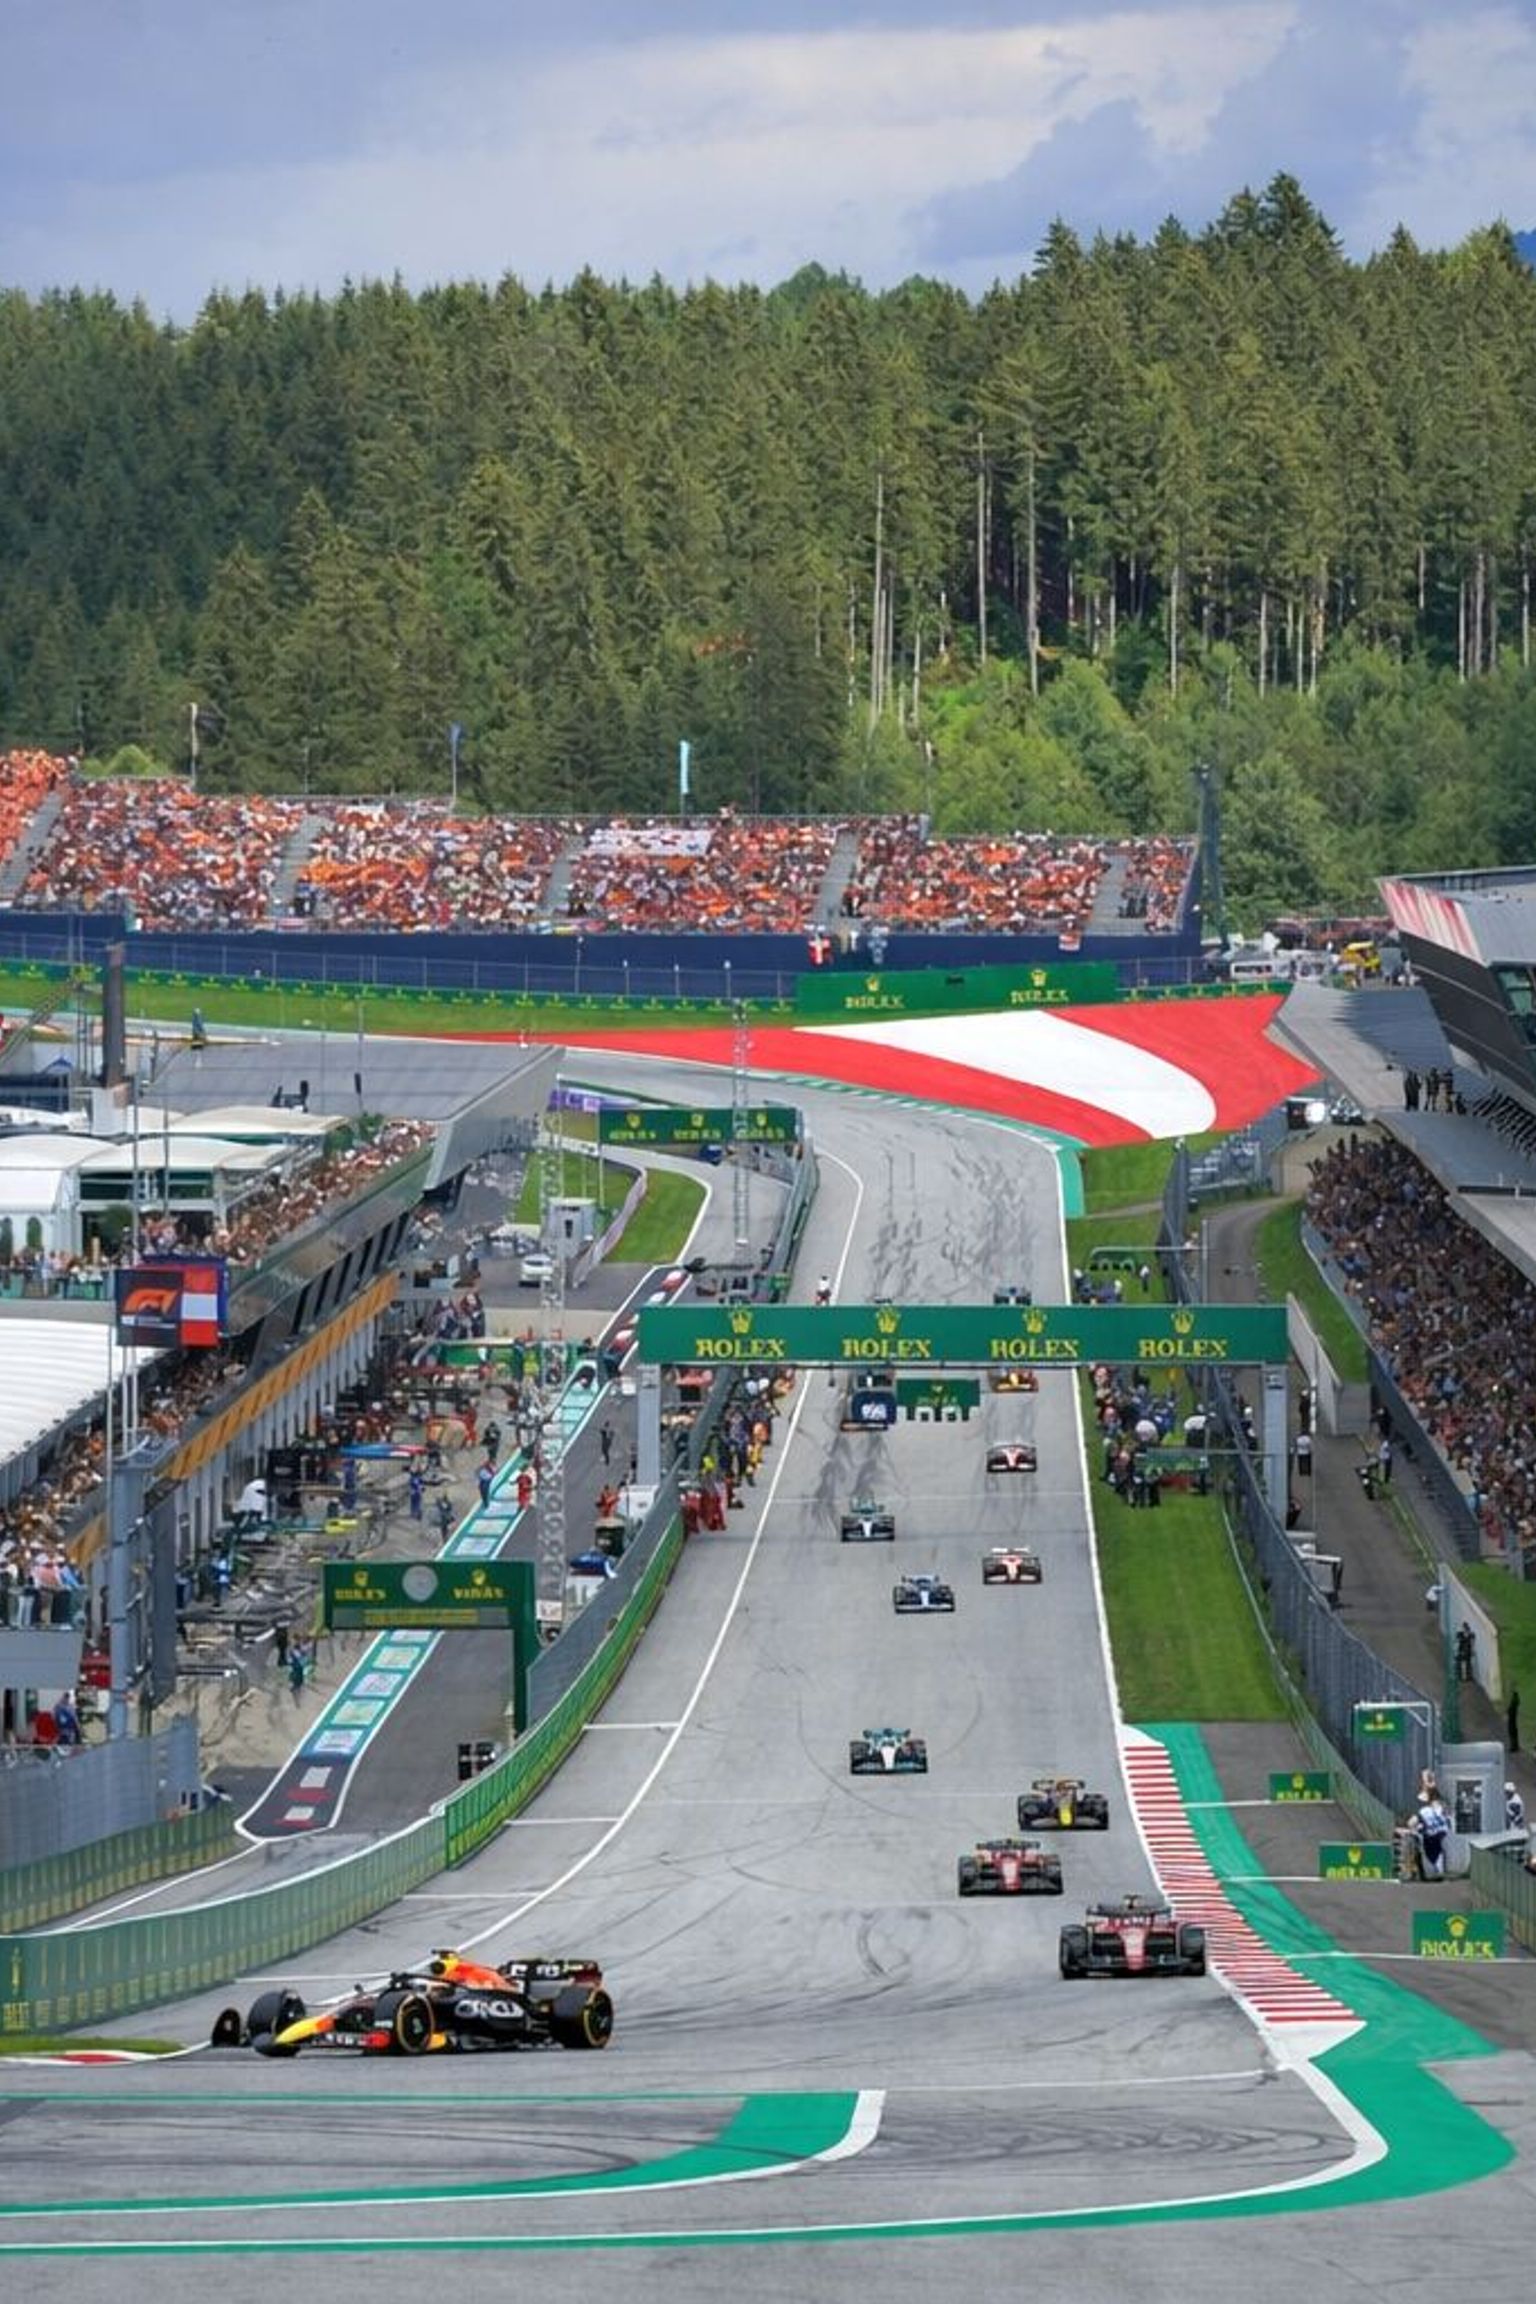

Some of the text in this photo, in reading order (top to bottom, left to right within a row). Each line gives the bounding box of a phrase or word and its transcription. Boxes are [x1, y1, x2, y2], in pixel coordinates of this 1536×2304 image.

[695, 1338, 1228, 1358] ROLEX ROLEX ROLEX ROLEX
